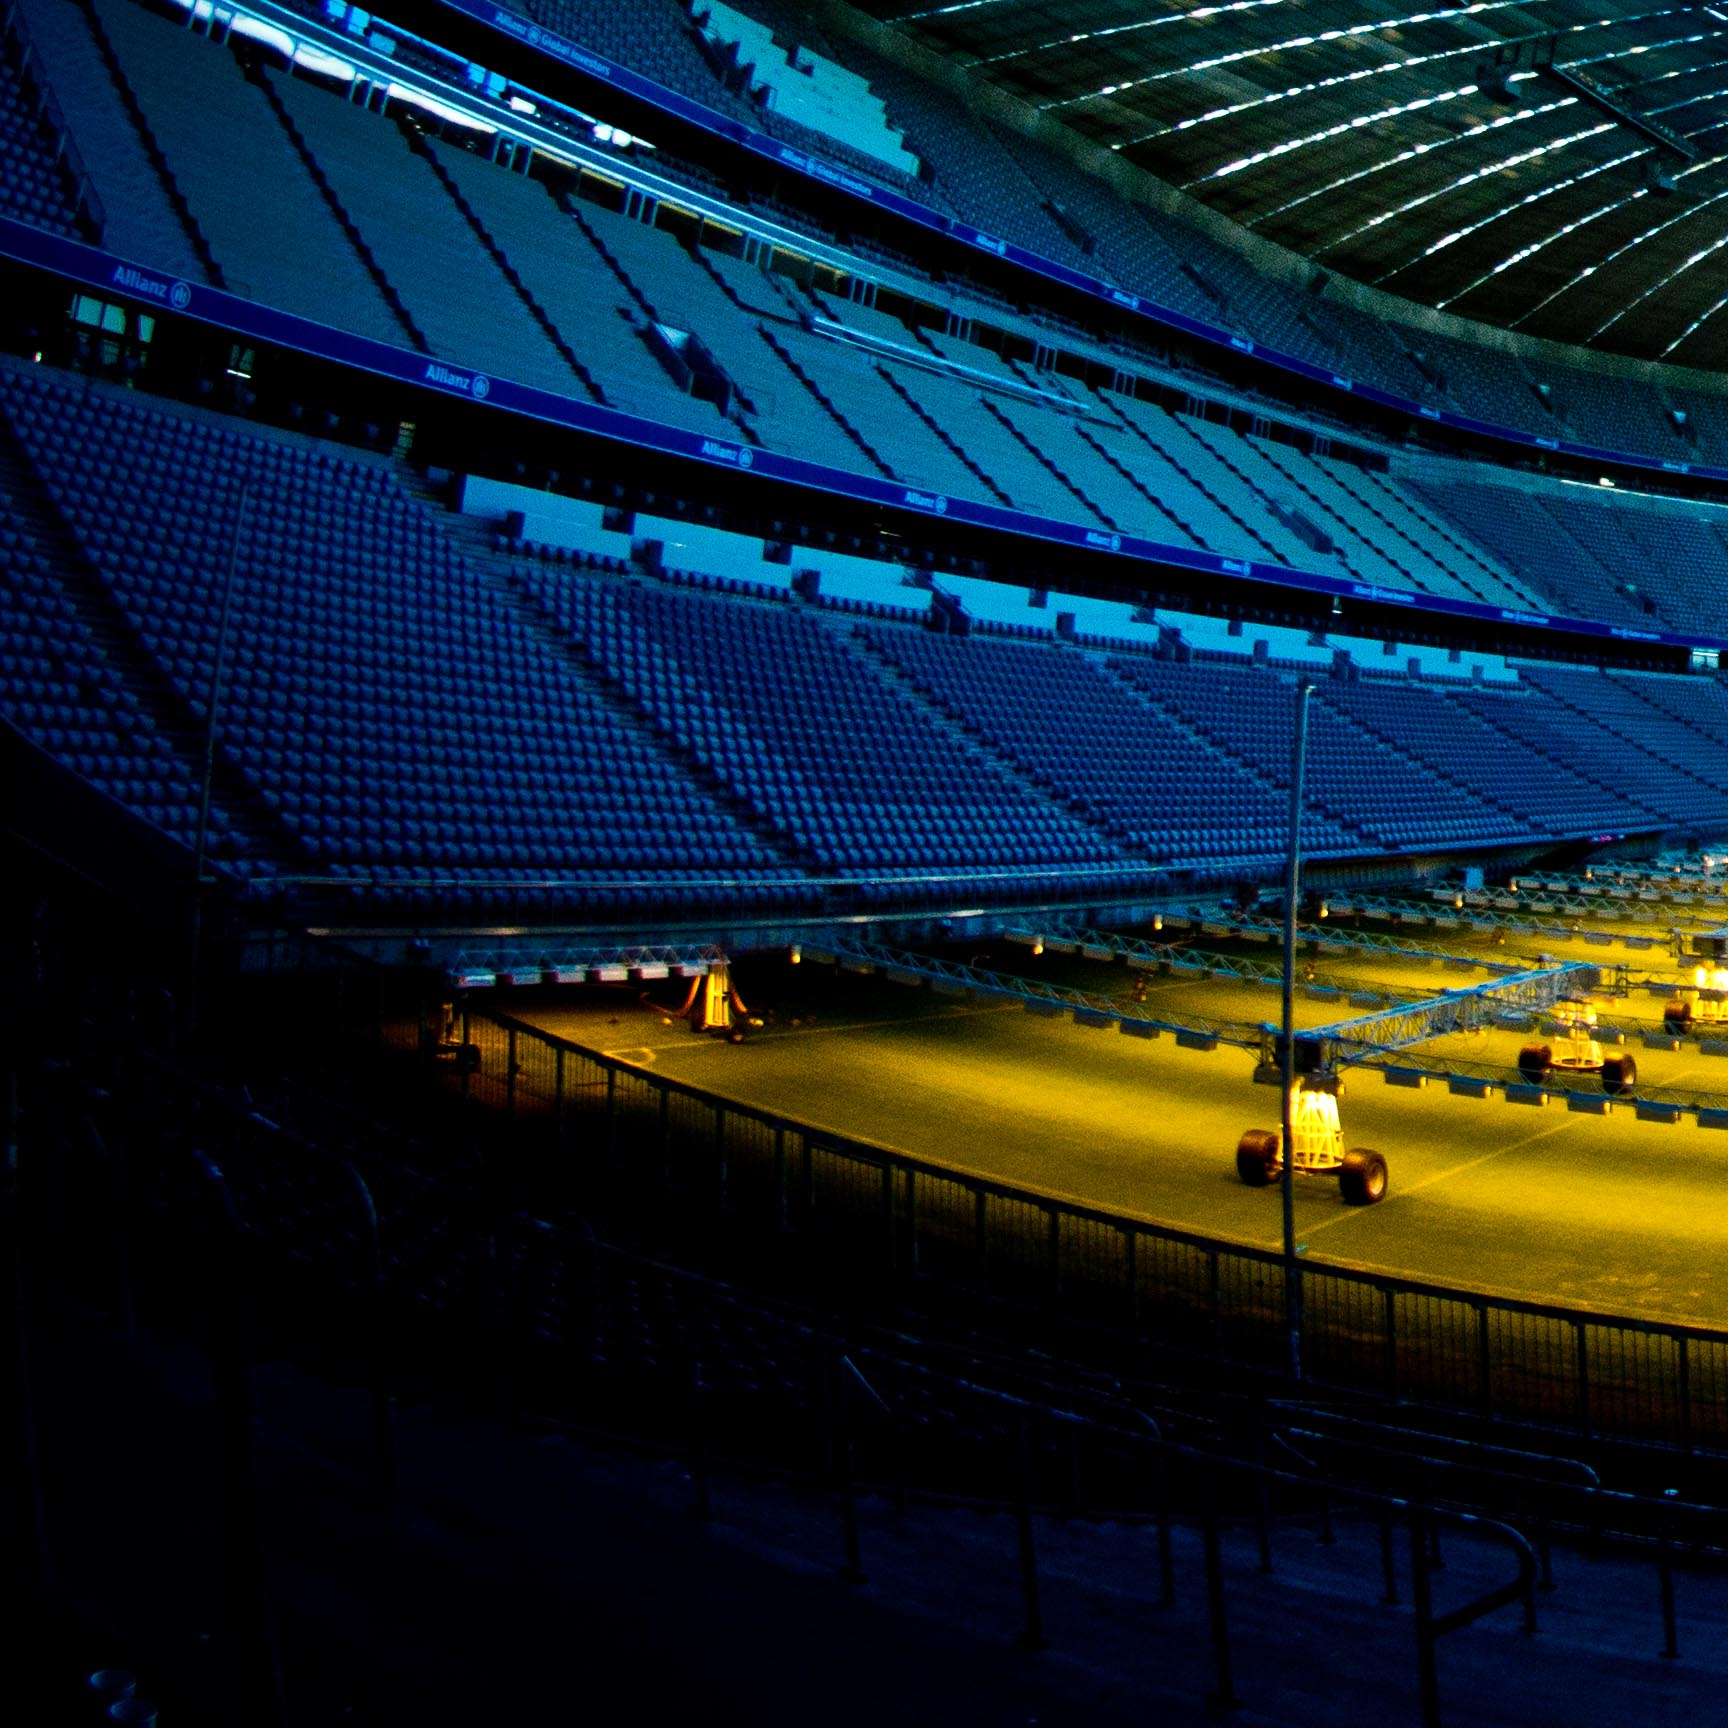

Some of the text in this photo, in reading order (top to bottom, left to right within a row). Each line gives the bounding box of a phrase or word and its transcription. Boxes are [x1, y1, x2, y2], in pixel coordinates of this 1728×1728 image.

[113, 265, 168, 298] Allianz
[425, 364, 471, 390] Allianz
[702, 440, 738, 461] Allianz
